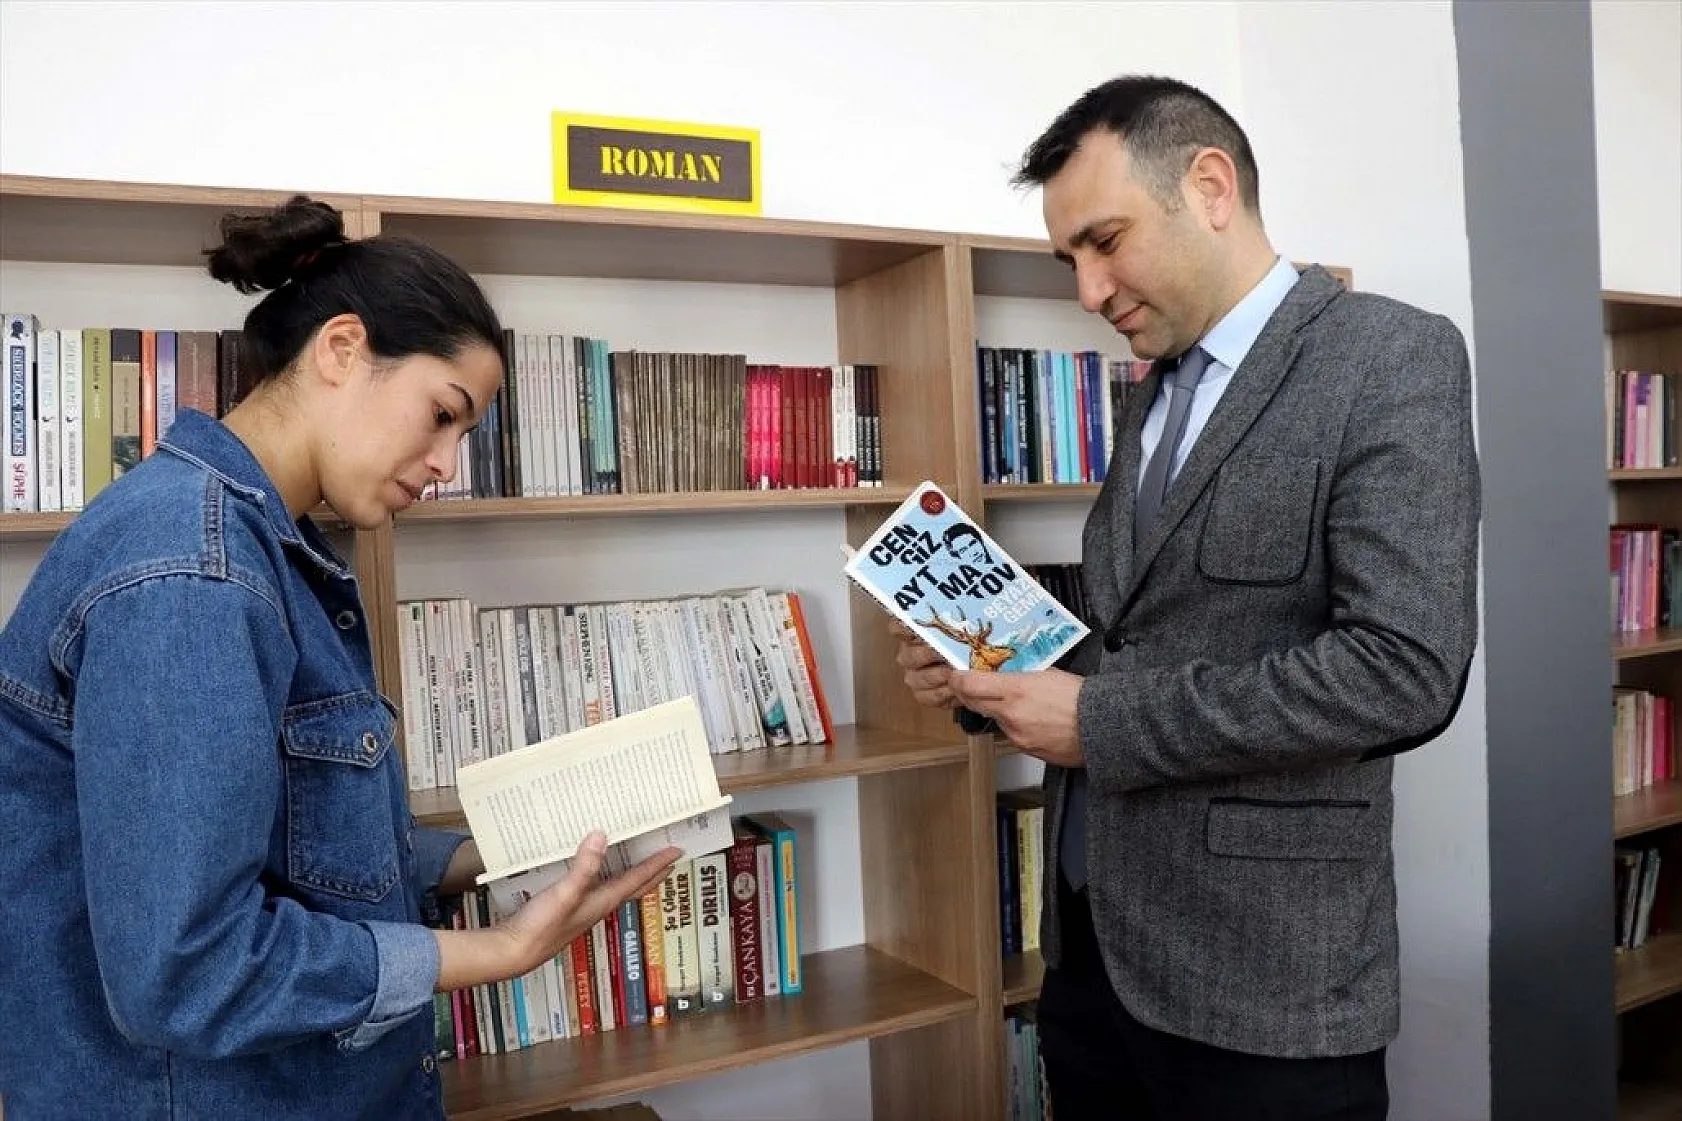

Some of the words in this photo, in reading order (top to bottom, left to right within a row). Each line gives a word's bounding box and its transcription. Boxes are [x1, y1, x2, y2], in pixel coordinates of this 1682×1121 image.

[600, 146, 722, 183] ROMAN
[869, 523, 919, 567] CEN
[894, 566, 939, 611] AYT
[937, 564, 983, 601] MA
[966, 563, 1017, 599] TOV
[739, 901, 760, 985] ÇANKAYA
